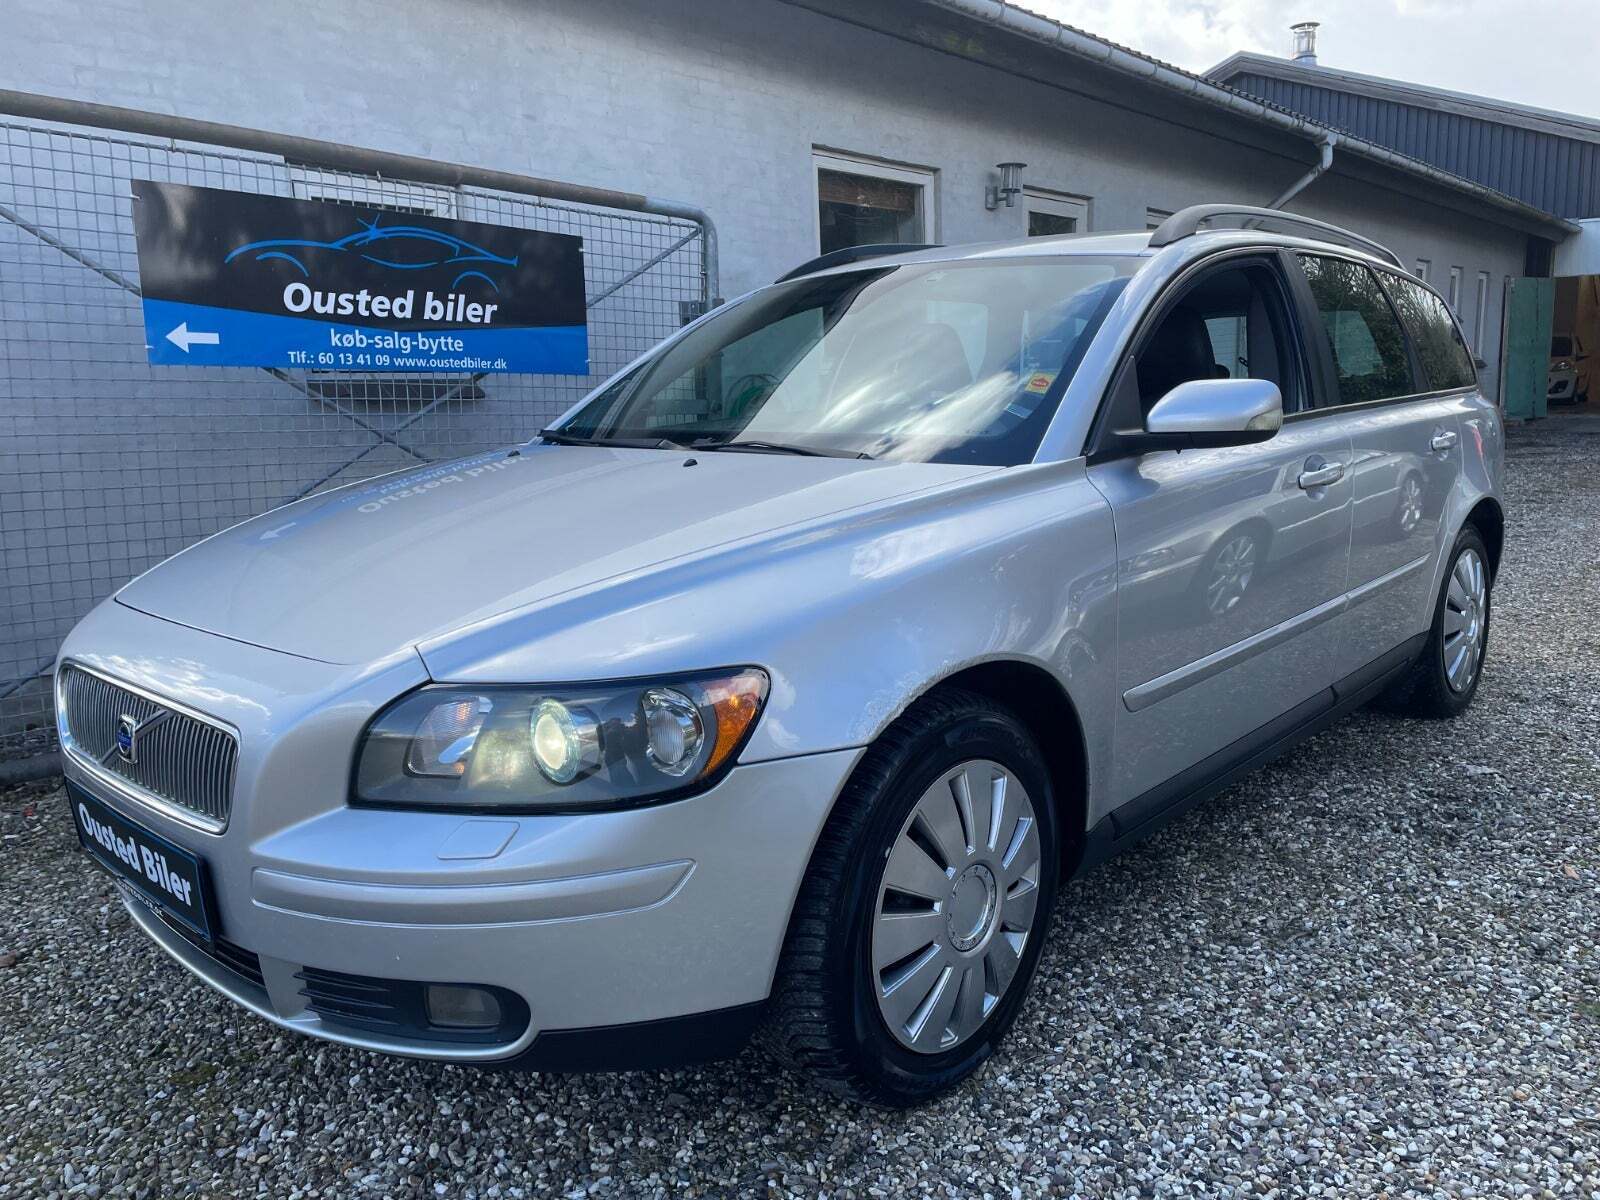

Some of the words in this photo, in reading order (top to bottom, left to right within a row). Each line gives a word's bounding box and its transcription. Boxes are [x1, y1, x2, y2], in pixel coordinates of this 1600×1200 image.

[283, 282, 415, 319] Ousted
[423, 291, 498, 324] biler
[330, 328, 464, 355] køb-salg-bytte
[287, 351, 314, 364] Tlf.:
[318, 352, 334, 365] 60
[338, 353, 353, 365] 13
[356, 354, 371, 366] 41
[375, 354, 390, 366] 09
[393, 356, 507, 369] www.oustedbiler.dk
[78, 802, 142, 873] Ousted
[140, 844, 192, 907] Biler
